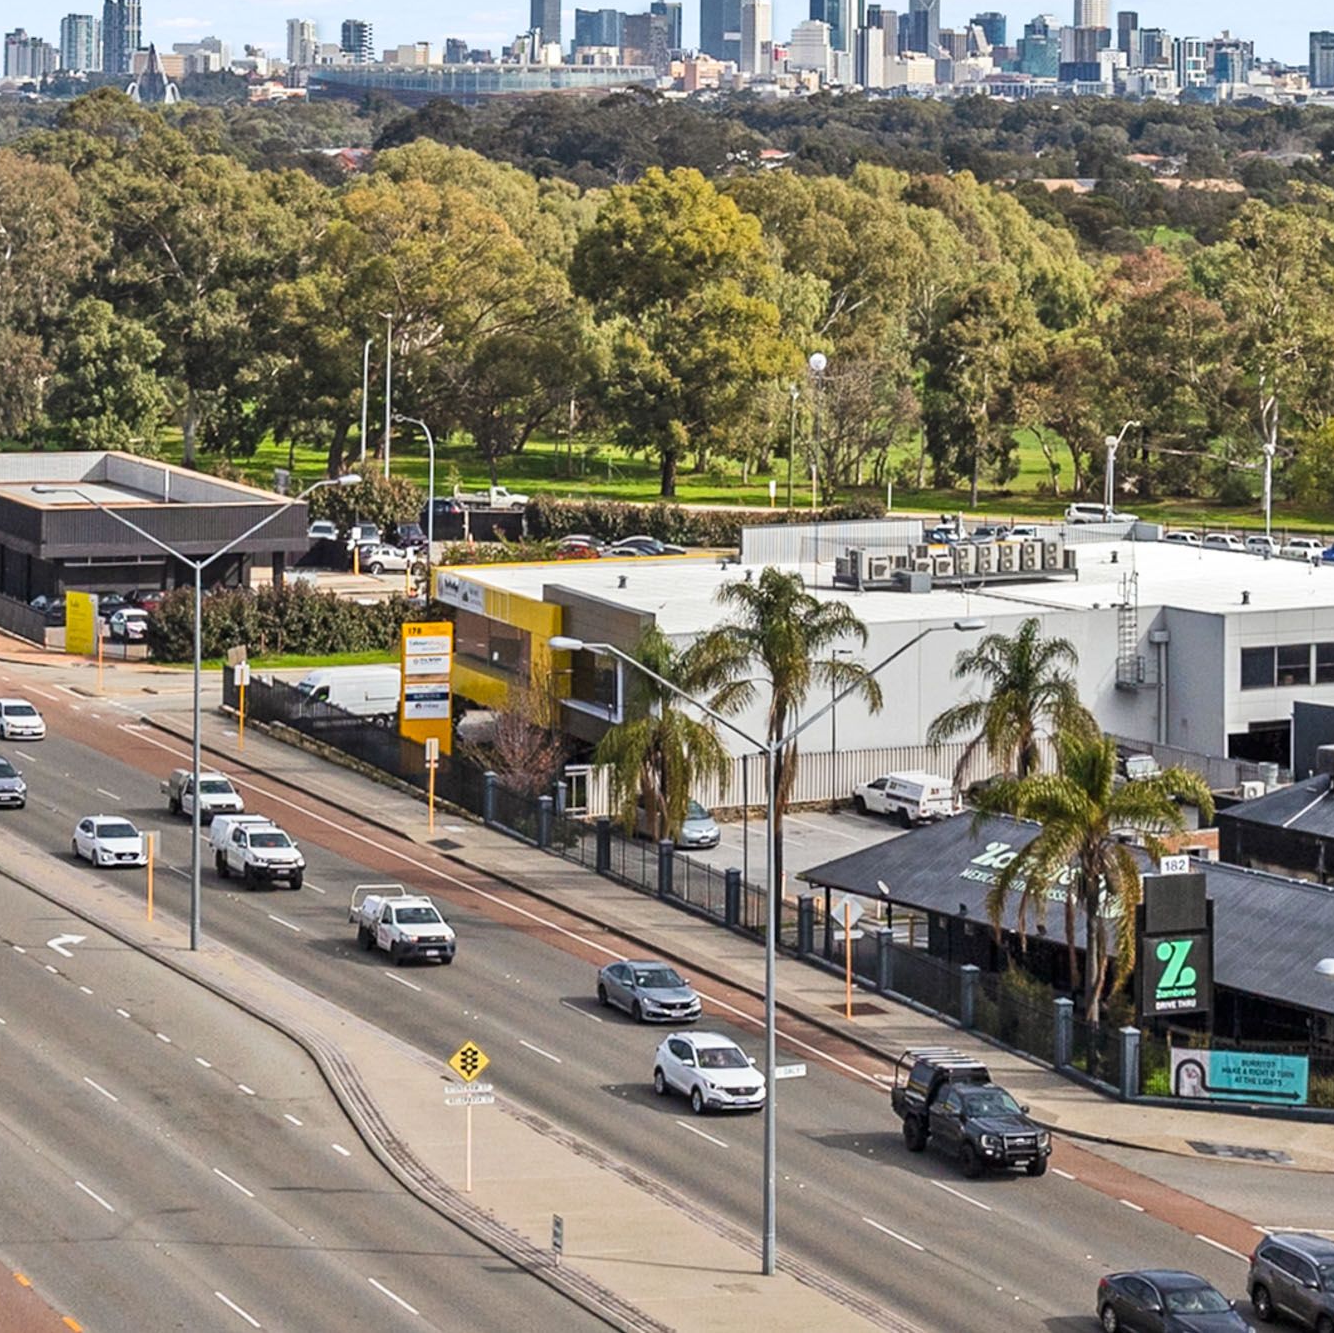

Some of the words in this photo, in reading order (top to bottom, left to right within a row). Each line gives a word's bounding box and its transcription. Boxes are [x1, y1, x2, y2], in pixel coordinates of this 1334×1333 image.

[1164, 859, 1186, 872] 182
[1156, 987, 1196, 999] Zambrero
[1156, 1000, 1178, 1010] DRIVE
[1178, 998, 1196, 1009] THRU
[1248, 1068, 1269, 1076] RIGHT
